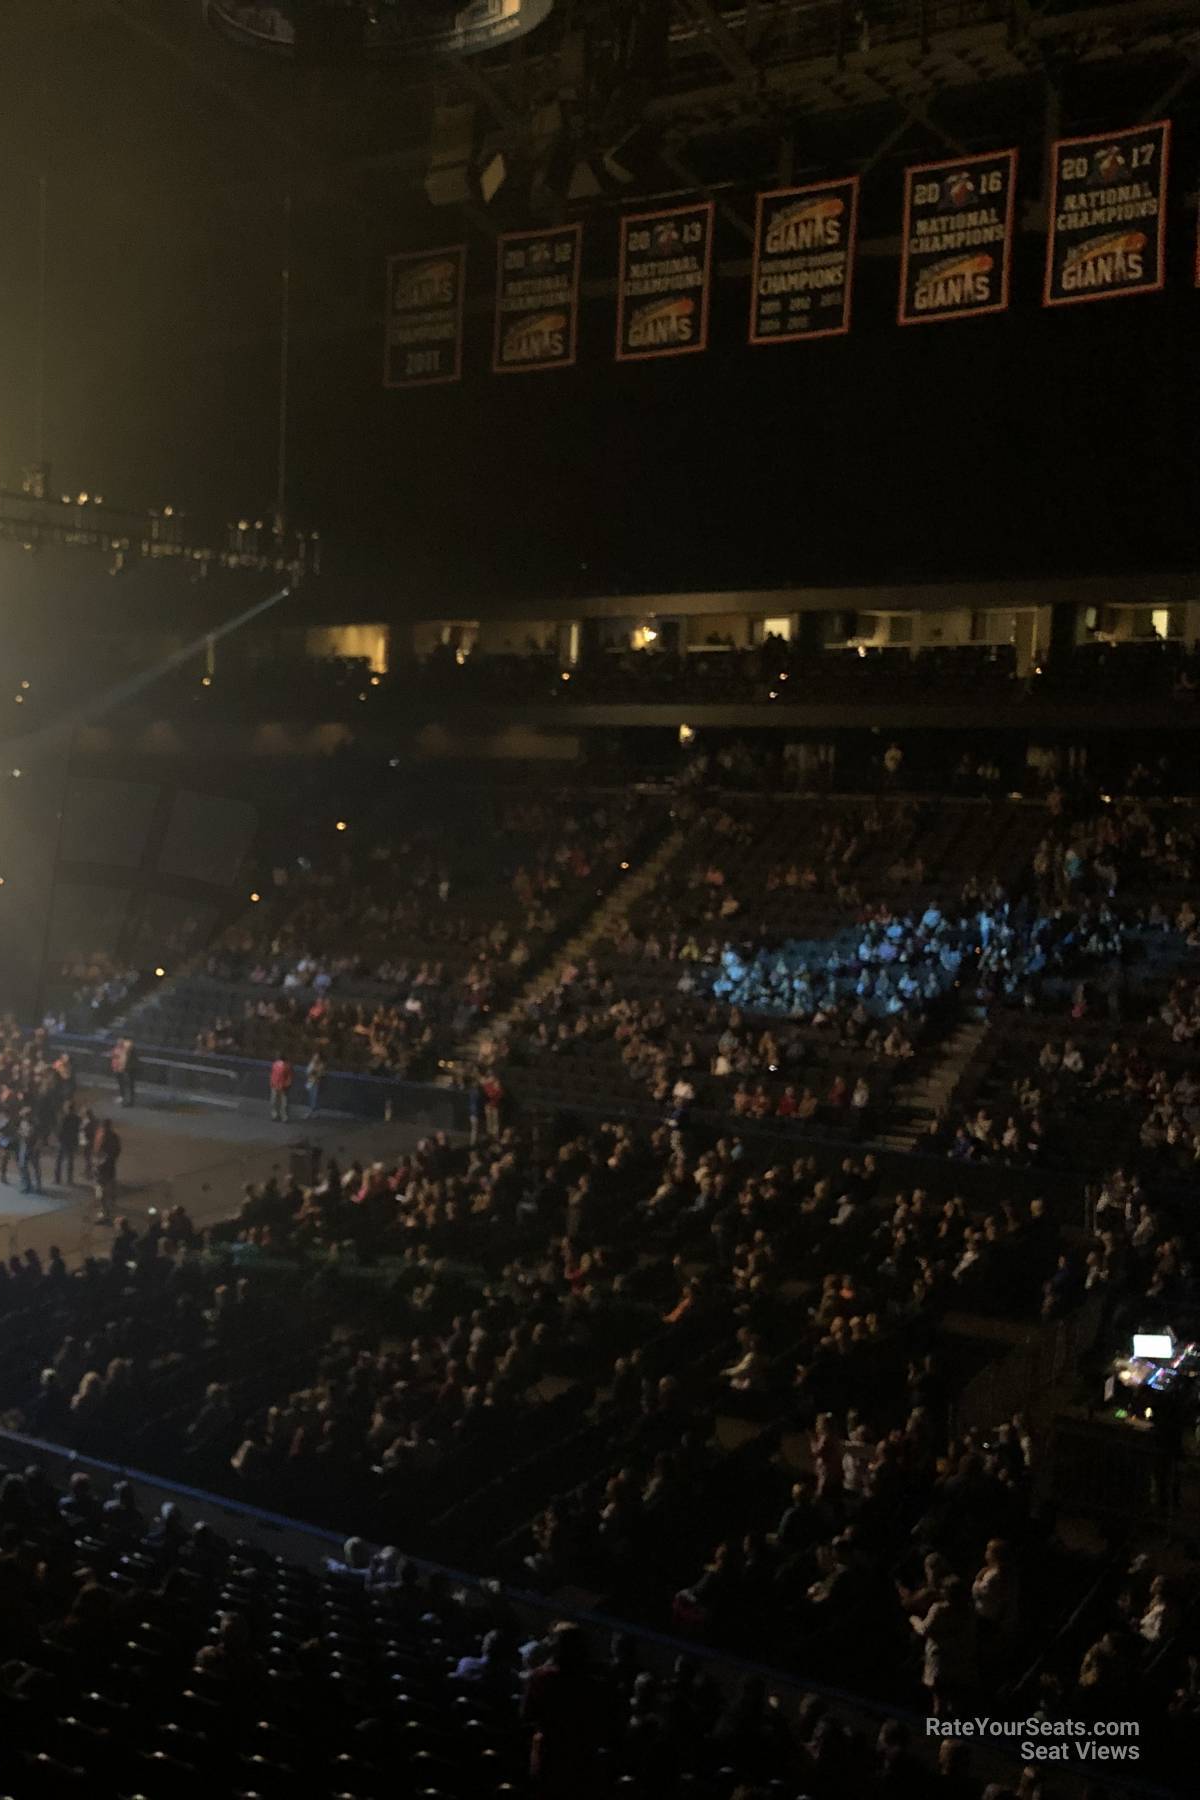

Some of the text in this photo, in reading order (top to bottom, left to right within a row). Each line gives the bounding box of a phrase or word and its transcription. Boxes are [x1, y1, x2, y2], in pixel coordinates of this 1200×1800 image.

[1061, 143, 1155, 180] 20 17
[913, 170, 1002, 206] 20 16
[1064, 182, 1153, 211] NATIONAL
[916, 207, 1000, 235] NATIONAL
[1057, 197, 1158, 231] CHAMPIONS
[766, 213, 841, 254] GIANTS
[910, 223, 1005, 254] CHAMPIONS
[759, 265, 844, 295] CHAMPIONS
[1061, 247, 1144, 290] GIANTS
[913, 271, 991, 310] GIANTS
[628, 312, 692, 346] GIANTS
